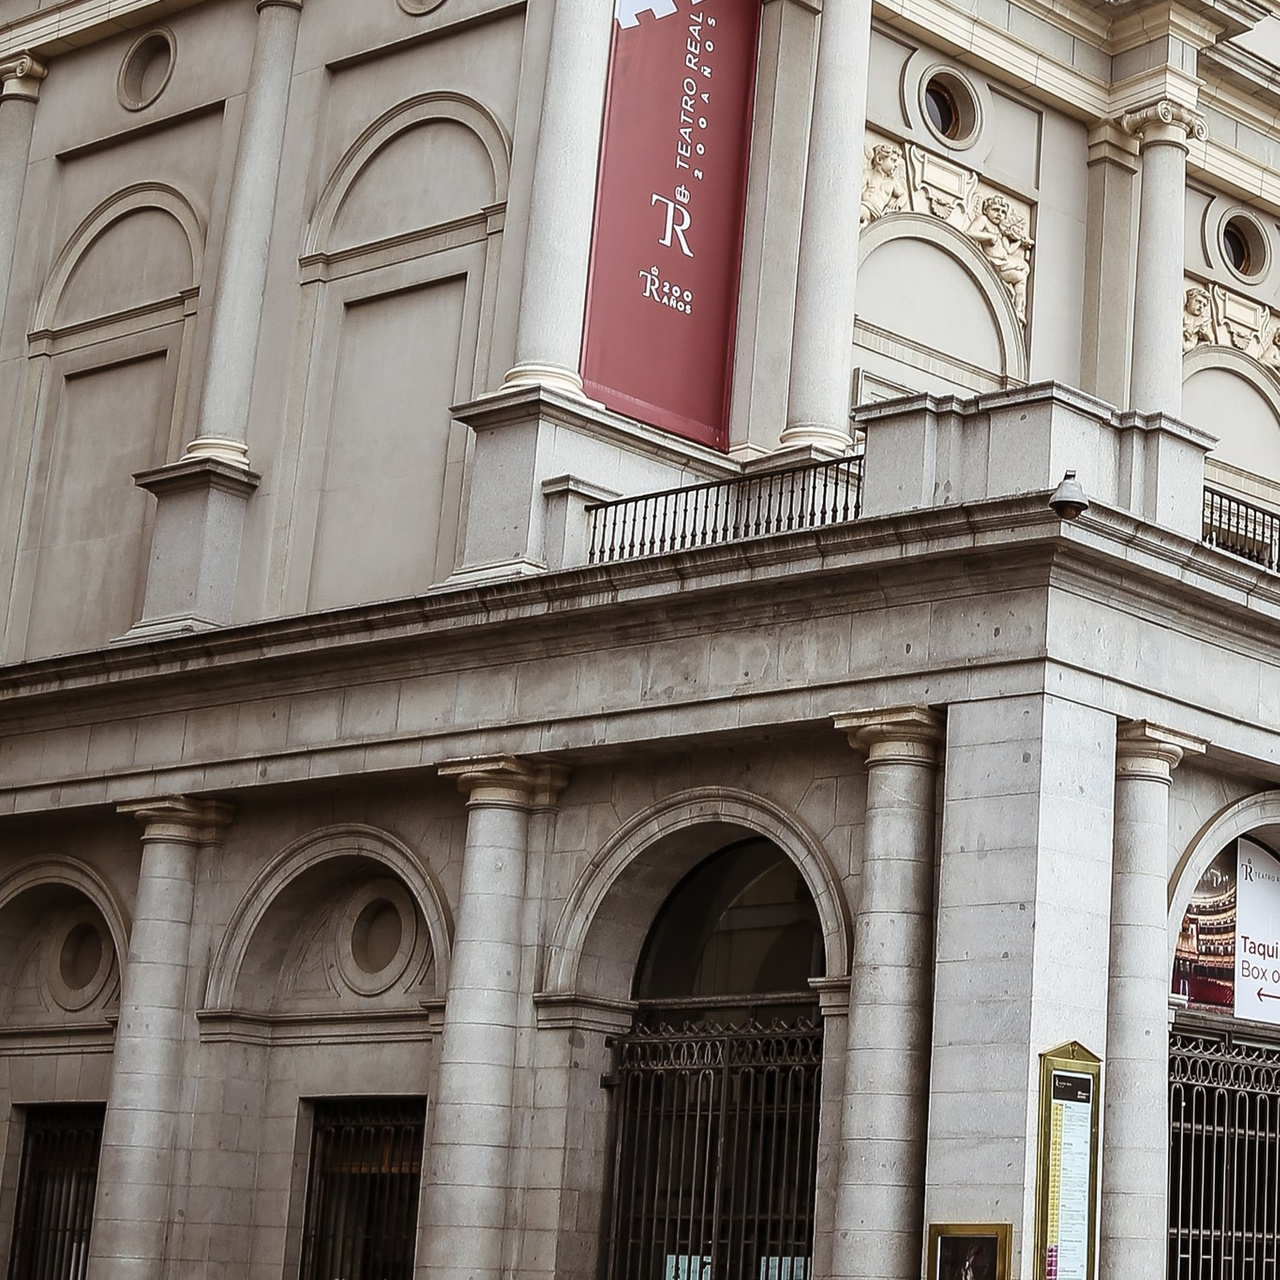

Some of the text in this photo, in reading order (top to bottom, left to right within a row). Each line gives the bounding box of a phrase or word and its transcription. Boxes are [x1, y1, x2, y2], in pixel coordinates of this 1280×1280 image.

[675, 11, 703, 170] TEATRO REAL
[693, 16, 716, 180] 200 AÑOS
[662, 281, 693, 302] 200
[661, 296, 692, 315] AÑOS
[1254, 871, 1276, 883] TEATRO
[1241, 959, 1268, 982] Box
